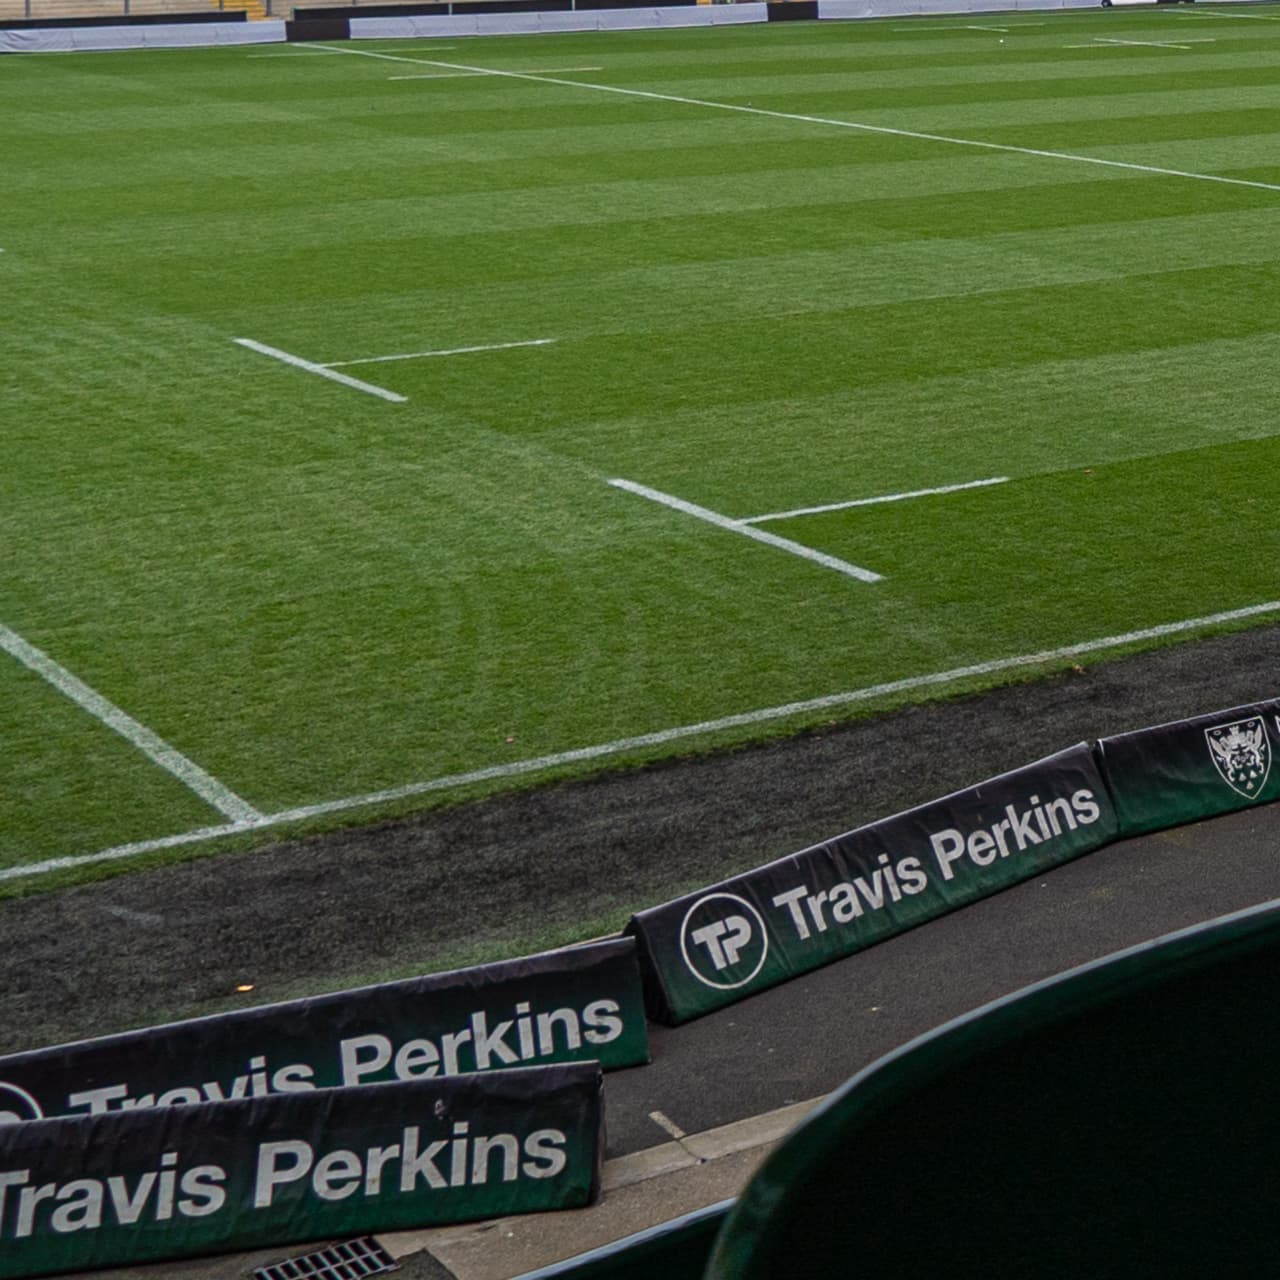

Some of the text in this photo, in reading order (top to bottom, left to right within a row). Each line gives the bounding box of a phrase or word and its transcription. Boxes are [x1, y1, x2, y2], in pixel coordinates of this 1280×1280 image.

[773, 852, 928, 941] Travis
[930, 787, 1100, 881] Perkins
[68, 997, 624, 1118] Tvis Perkins
[254, 1121, 568, 1209] Perkins
